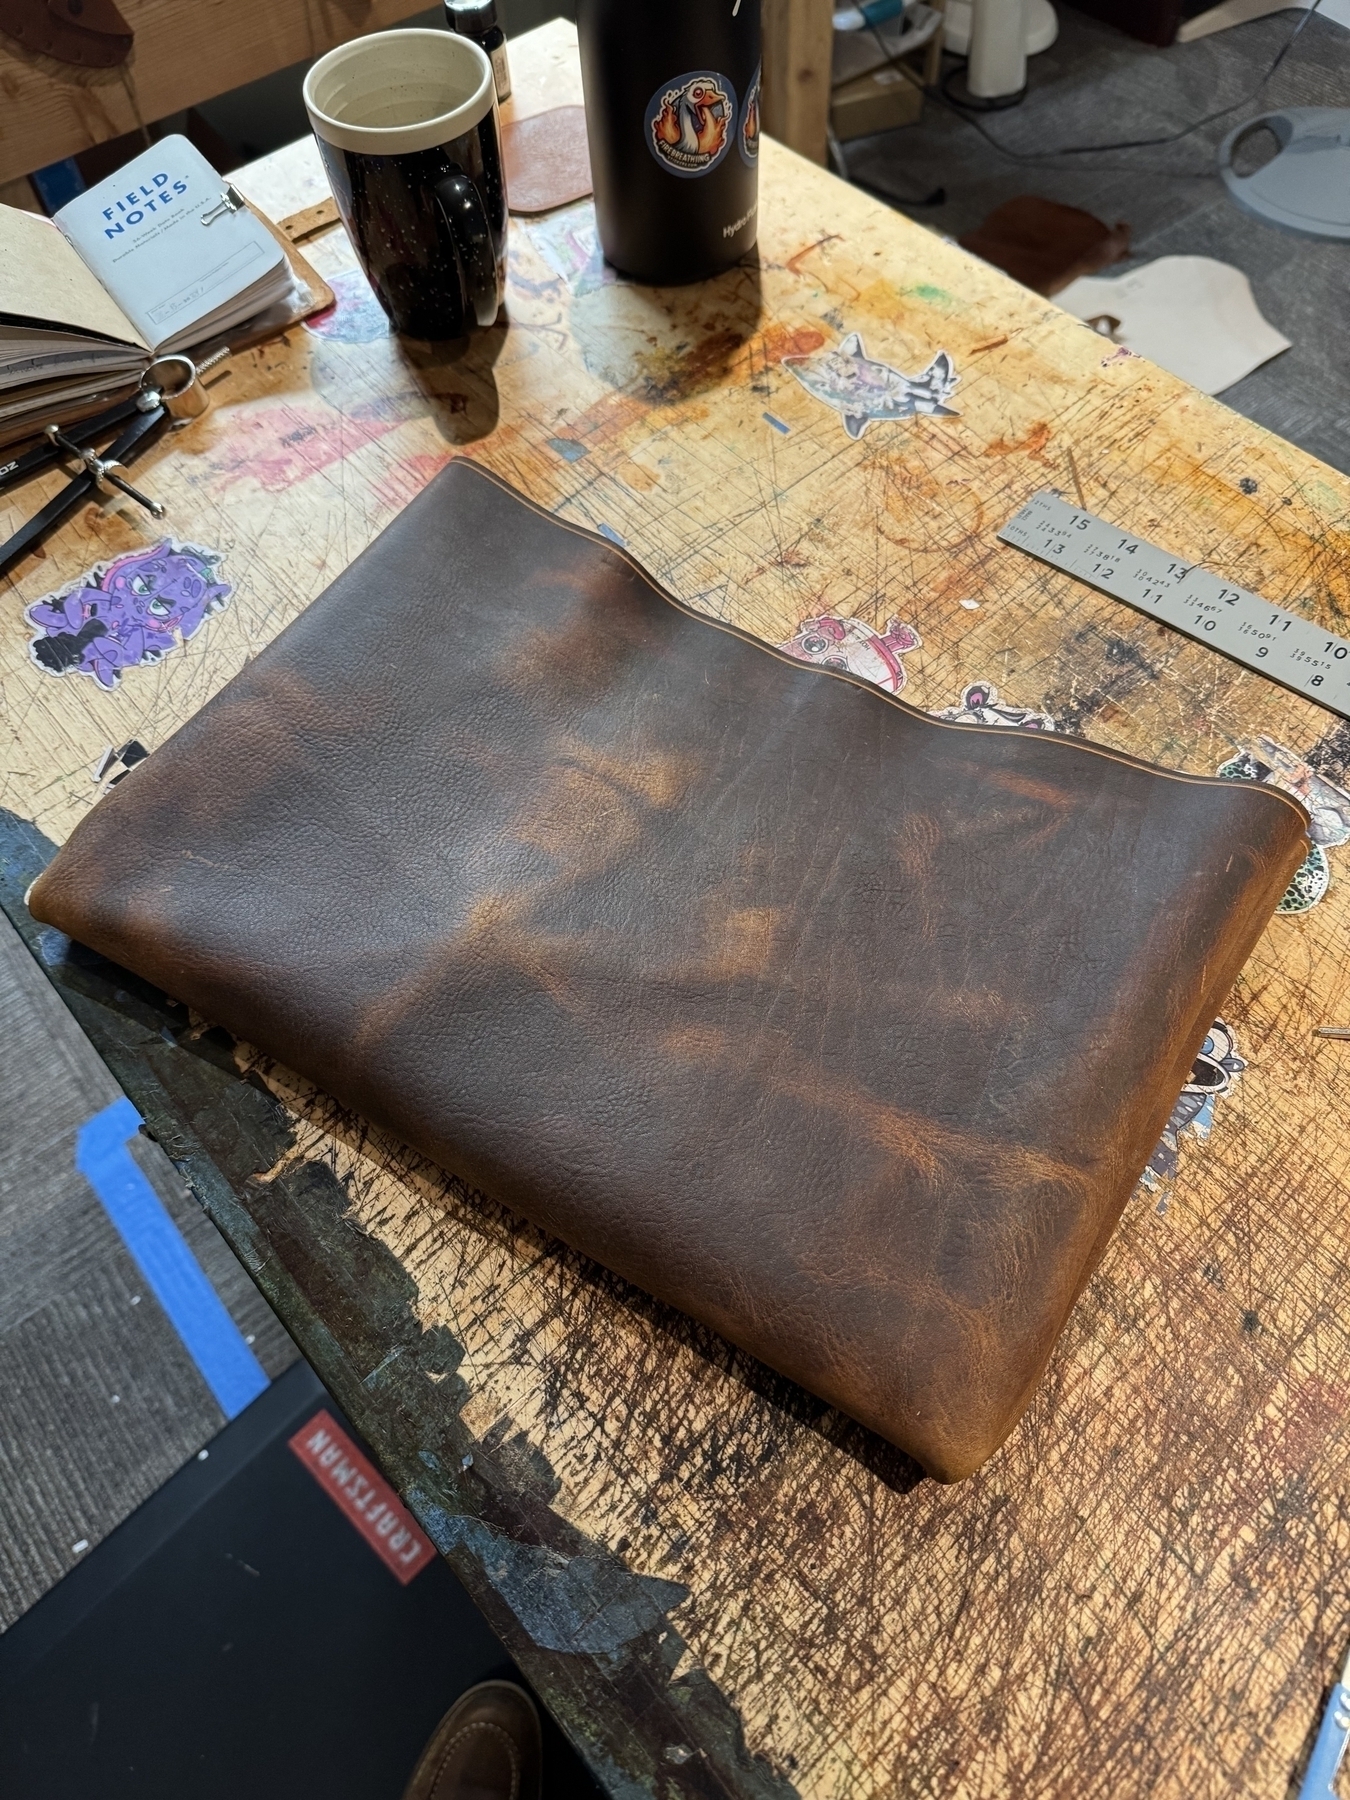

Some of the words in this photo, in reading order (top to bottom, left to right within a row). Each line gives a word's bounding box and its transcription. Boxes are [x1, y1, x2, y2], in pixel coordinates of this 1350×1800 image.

[102, 173, 168, 221] FIELD
[104, 180, 187, 239] NOTES
[135, 231, 160, 249] Materials
[164, 219, 179, 230] Made
[186, 207, 195, 216] the
[723, 217, 747, 238] Hydro
[1069, 515, 1091, 530] 15
[1044, 539, 1066, 554] 13
[1117, 539, 1139, 554] 14
[1092, 563, 1114, 579] 12
[1167, 563, 1187, 581] 13
[1142, 589, 1163, 604] 11
[1218, 589, 1240, 606] 12
[1194, 615, 1216, 631] 10
[1269, 614, 1292, 632] 11
[1255, 646, 1269, 658] 9
[1324, 641, 1348, 660] 10
[1311, 675, 1325, 687] 8
[306, 1428, 423, 1565] CRAFTSMAN
